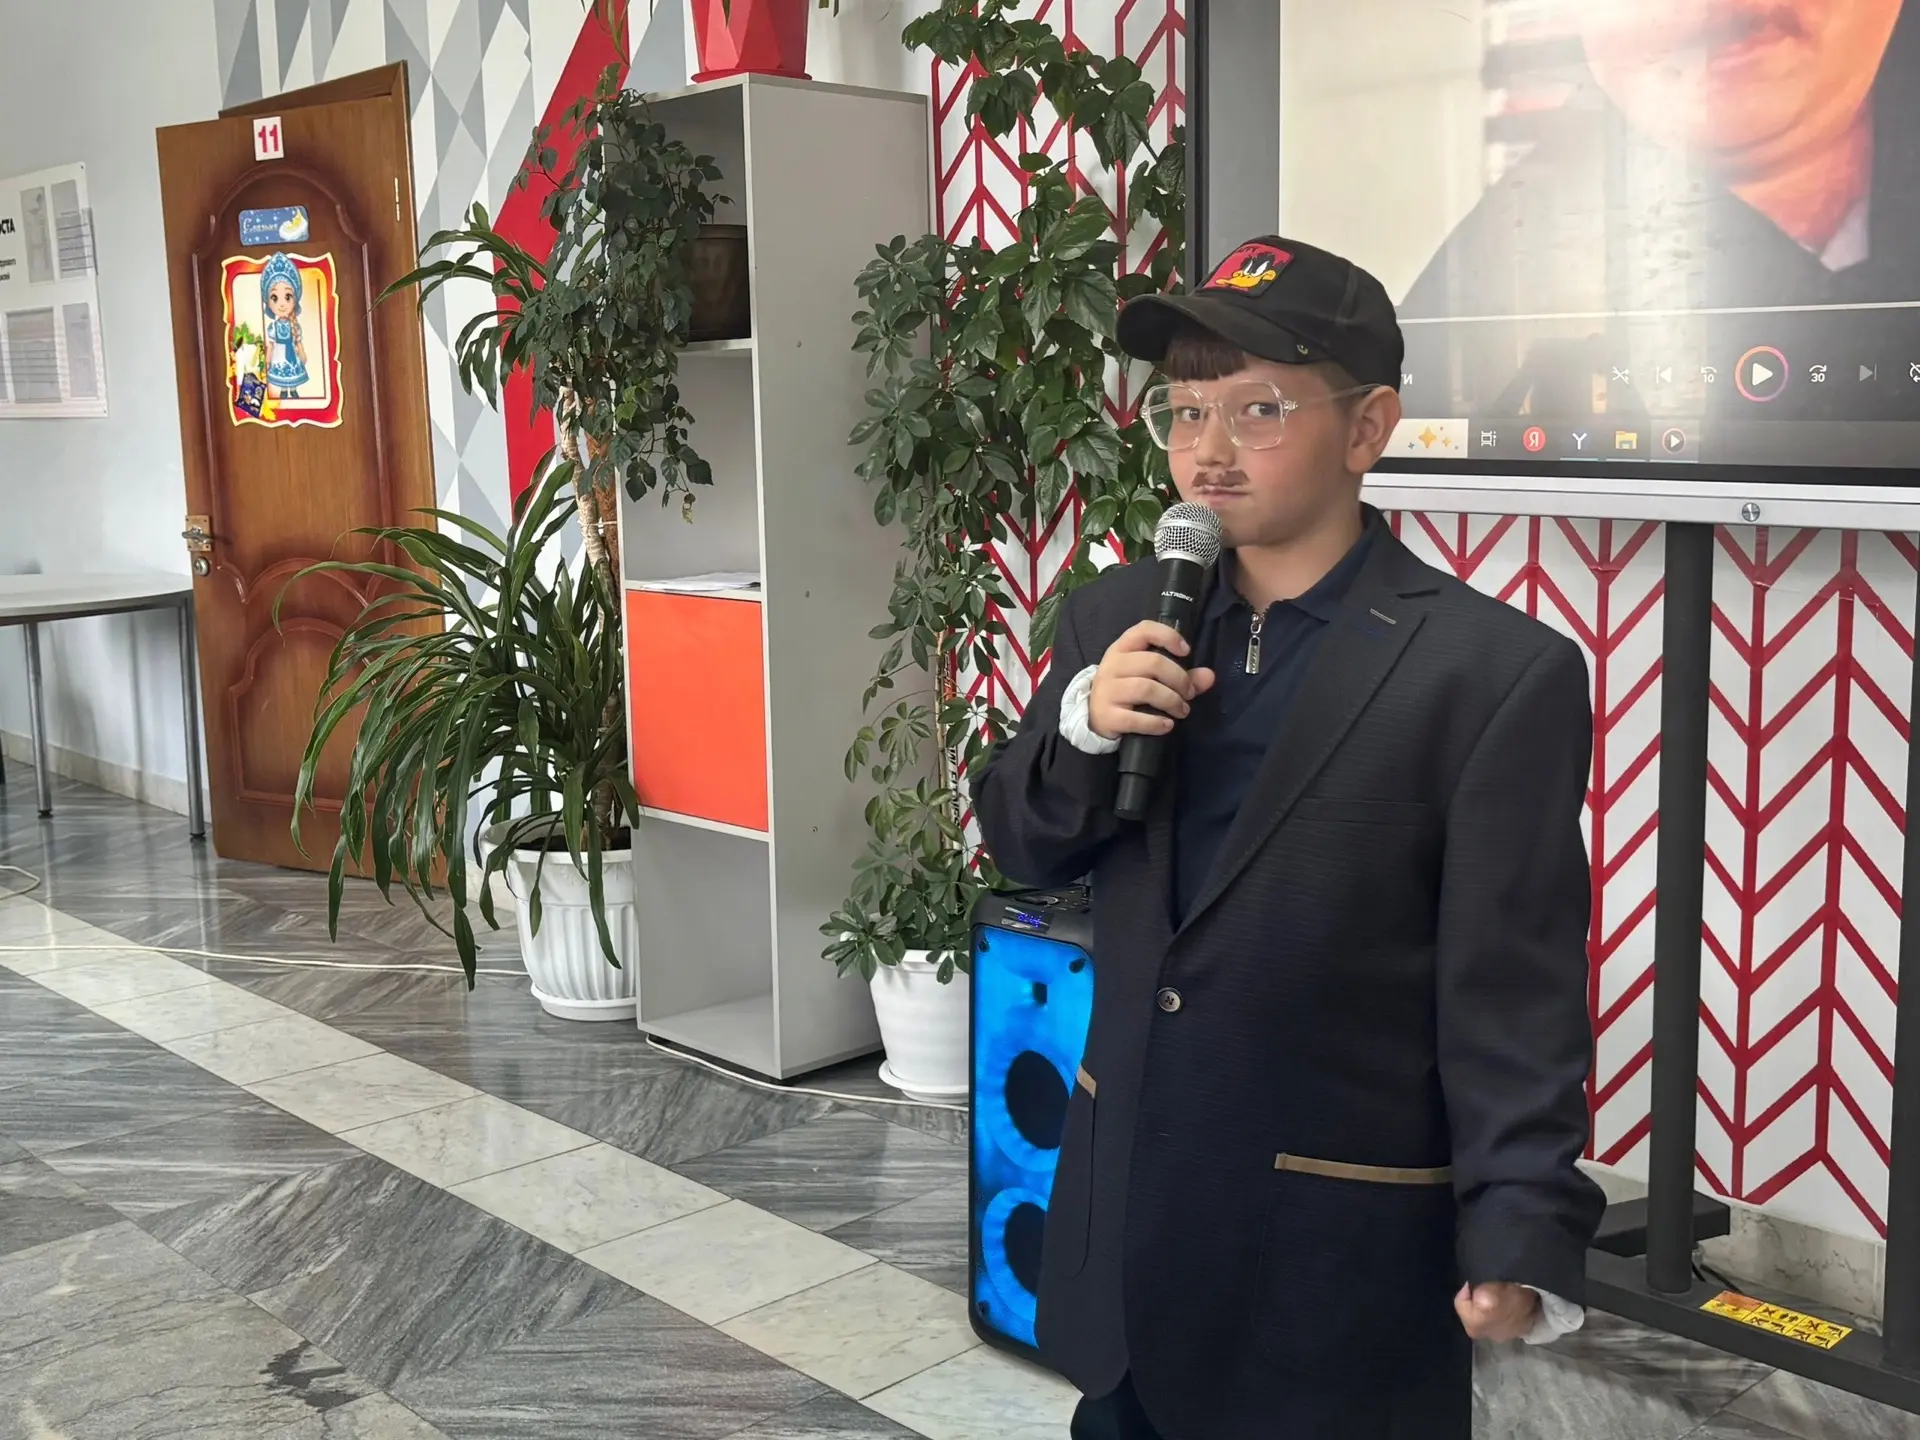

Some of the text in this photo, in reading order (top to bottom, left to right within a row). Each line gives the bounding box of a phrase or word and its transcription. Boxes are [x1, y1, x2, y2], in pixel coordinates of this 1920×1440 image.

[258, 124, 279, 153] 11
[0, 217, 15, 235] СТА
[1703, 373, 1715, 383] 10
[1810, 372, 1826, 383] 30
[1529, 431, 1539, 447] Я
